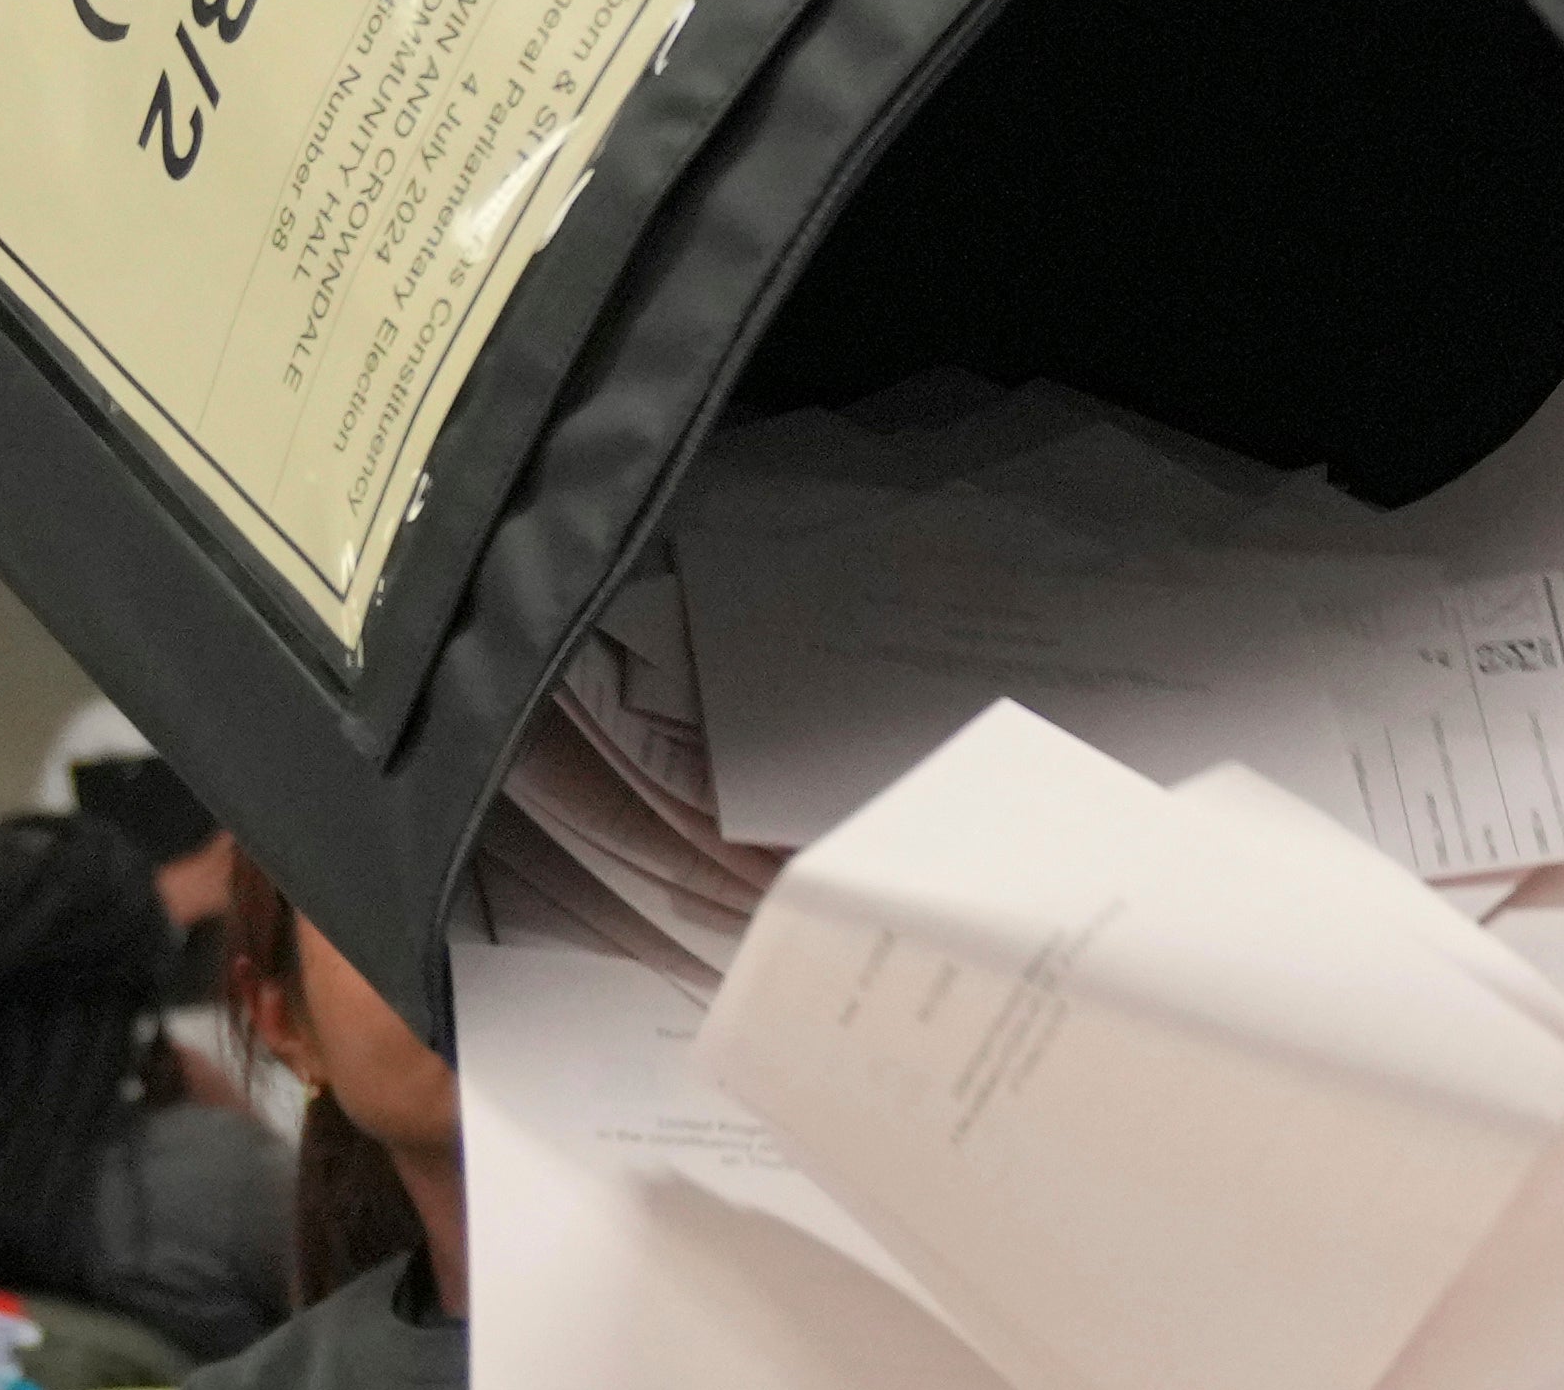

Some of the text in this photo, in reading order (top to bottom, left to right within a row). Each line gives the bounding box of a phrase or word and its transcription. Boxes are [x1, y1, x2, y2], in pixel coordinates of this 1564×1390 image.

[294, 63, 362, 199] Number
[394, 54, 441, 139] AND
[528, 104, 559, 144] St
[552, 69, 578, 95] &
[271, 207, 296, 252] 58
[292, 191, 341, 282] HALL
[375, 72, 480, 266] 4 July 2024
[394, 79, 525, 311] Parliamentary
[283, 148, 396, 392] CROWNDALE
[333, 318, 399, 453] Election
[347, 297, 452, 516] Constituency
